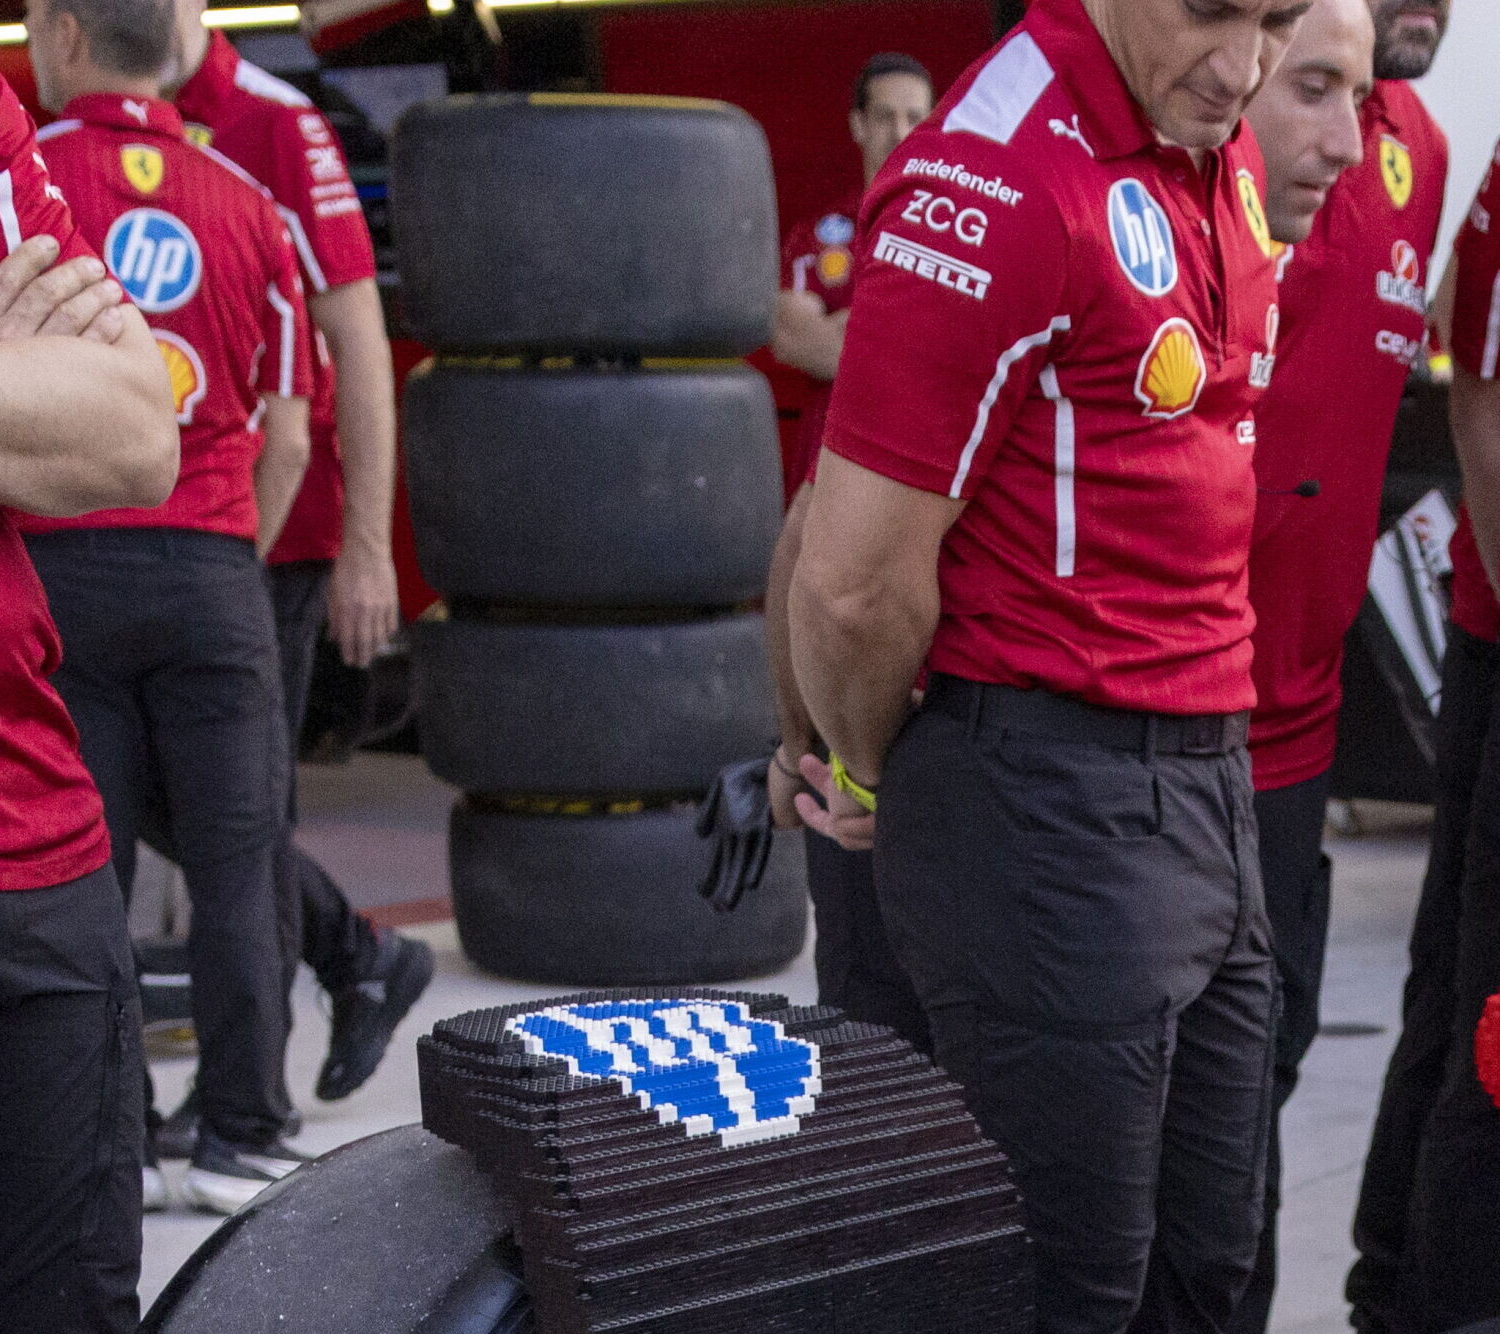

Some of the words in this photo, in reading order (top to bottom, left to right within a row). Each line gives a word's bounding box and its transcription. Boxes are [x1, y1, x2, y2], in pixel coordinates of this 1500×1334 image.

[902, 158, 1024, 206] Bitdefender
[901, 189, 988, 247] ZCG
[1114, 180, 1167, 292] hp
[119, 213, 190, 302] hp
[872, 231, 993, 300] PIRELLI
